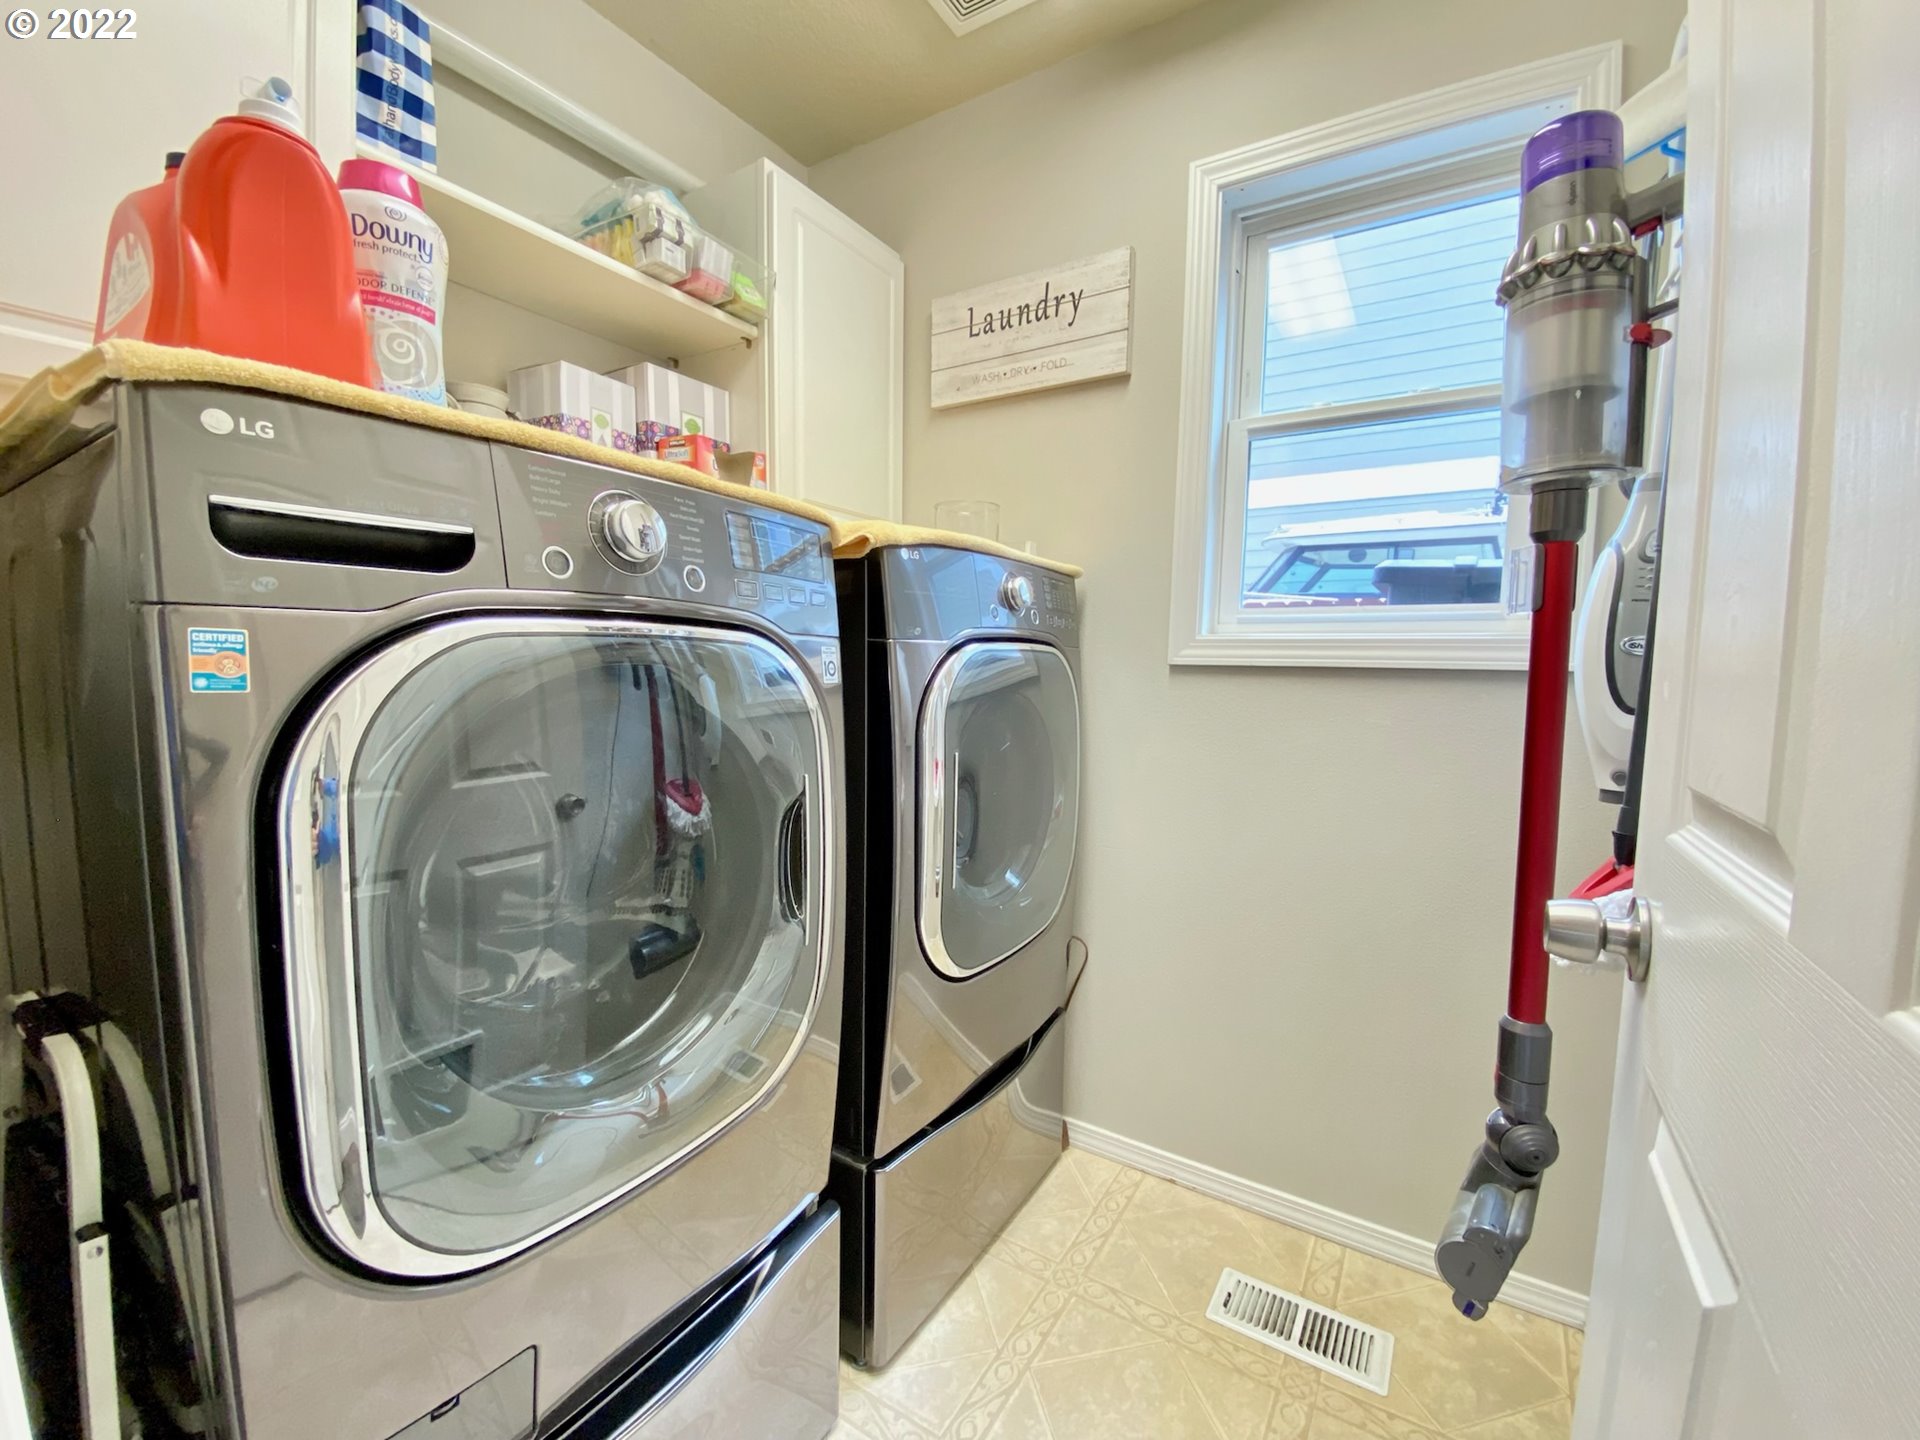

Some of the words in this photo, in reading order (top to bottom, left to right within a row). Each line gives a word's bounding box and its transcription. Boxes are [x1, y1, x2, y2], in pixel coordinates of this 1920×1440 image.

[351, 213, 433, 264] Downy
[353, 239, 379, 250] fresh
[382, 244, 418, 263] protect
[967, 281, 1083, 338] Laundry
[970, 371, 1000, 384] WASH
[1010, 365, 1030, 378] DRY
[1040, 357, 1067, 371] FOLD
[239, 417, 275, 439] LG
[909, 550, 920, 560] LG
[192, 632, 244, 642] CERTIFIED
